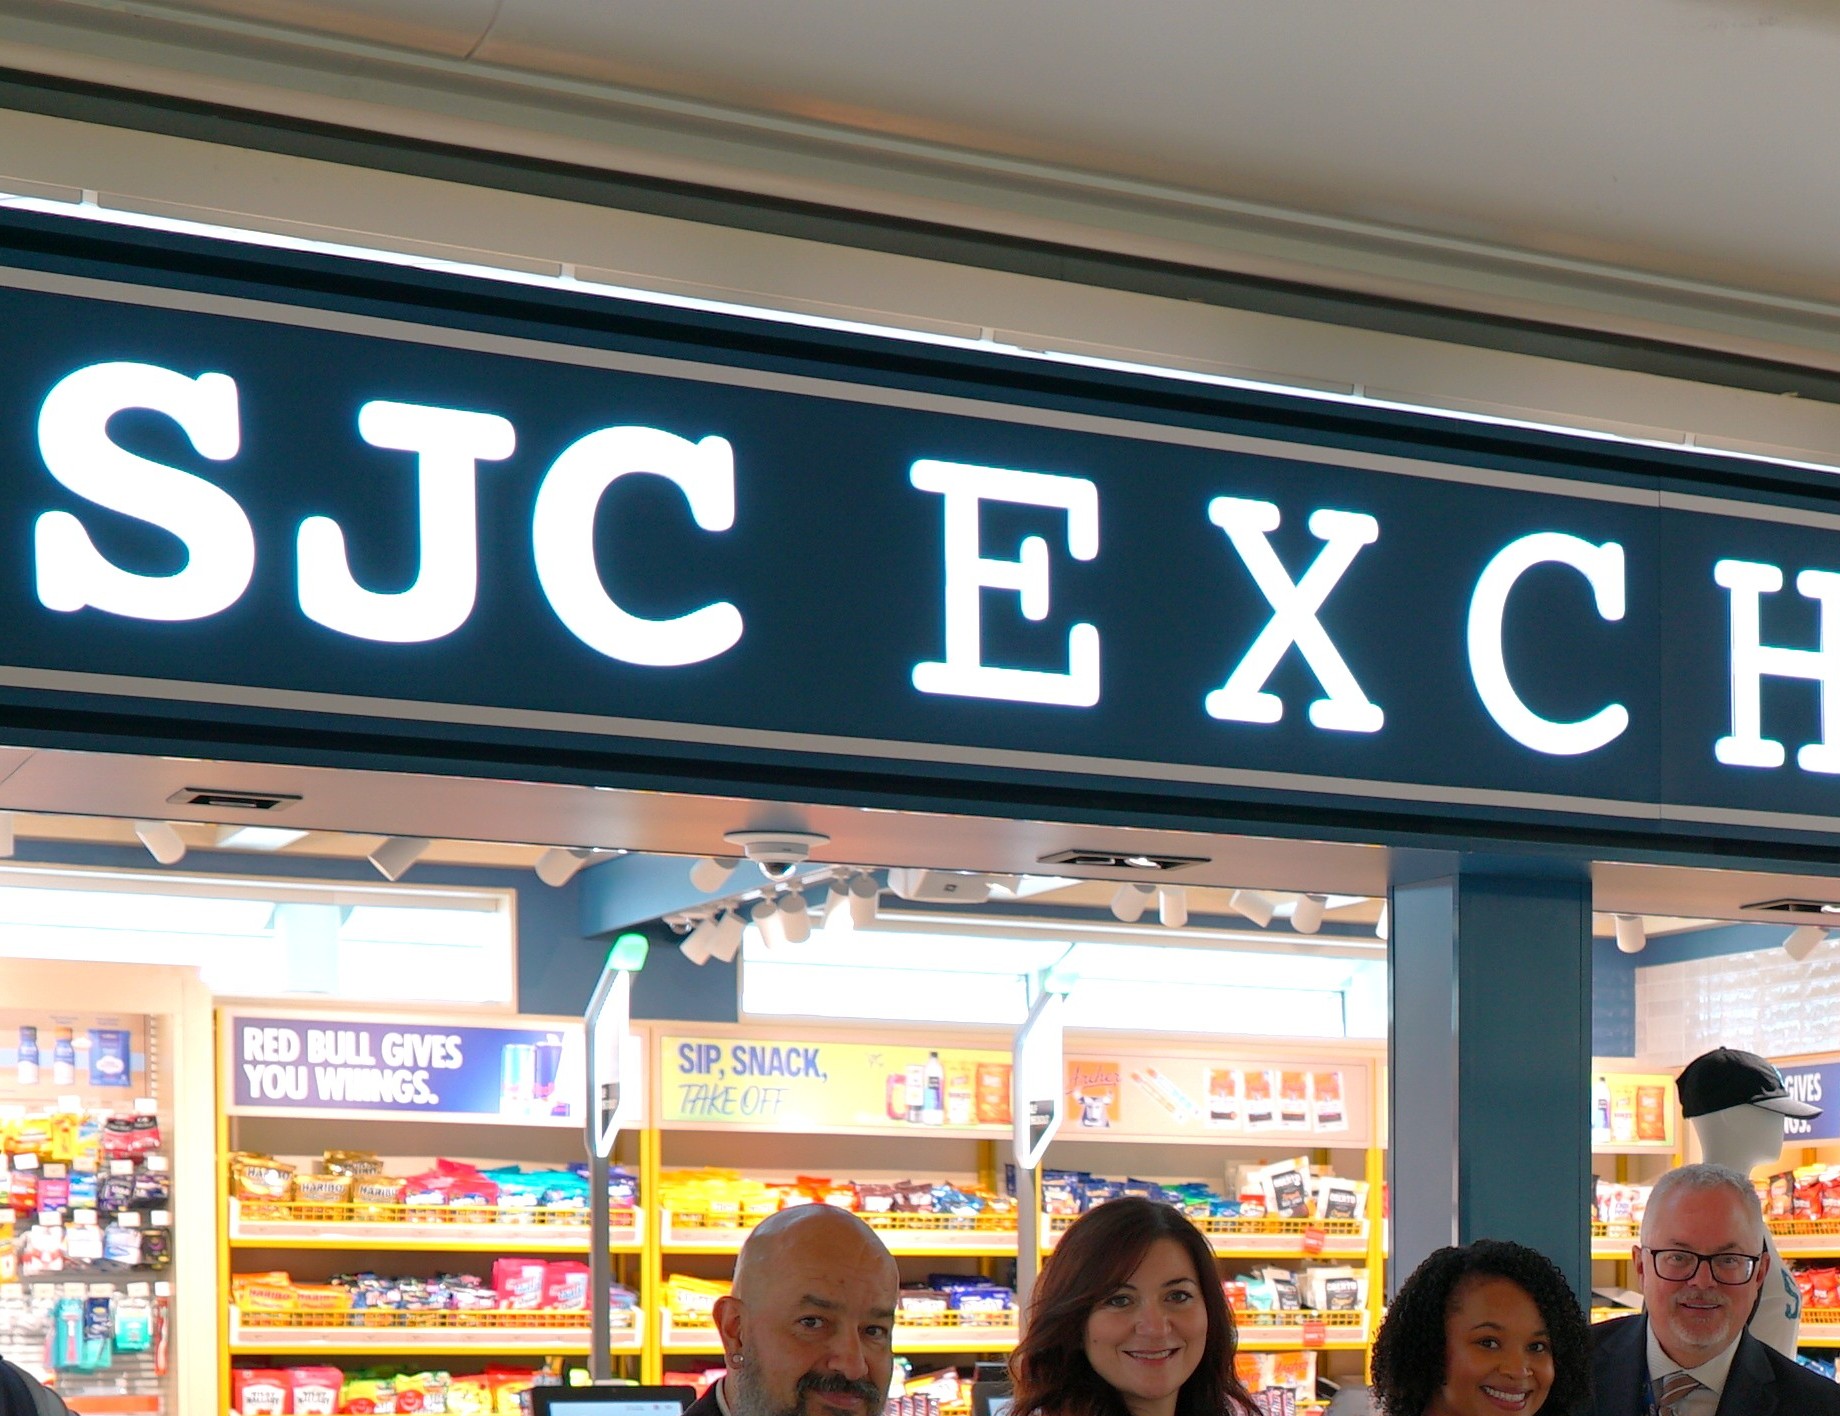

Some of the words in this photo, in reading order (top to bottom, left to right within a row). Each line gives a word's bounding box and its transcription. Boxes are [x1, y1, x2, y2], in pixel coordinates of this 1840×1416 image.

[36, 361, 743, 667] SJC
[243, 1027, 300, 1062] RED
[307, 1029, 376, 1066] BULL
[382, 1032, 463, 1069] GIVES
[678, 1042, 725, 1080] SIP,
[732, 1044, 827, 1083] SNACK,
[243, 1064, 308, 1100] YOU
[679, 1083, 737, 1116] TAKE
[740, 1085, 789, 1116] OFF
[302, 1182, 343, 1194] HARIBO
